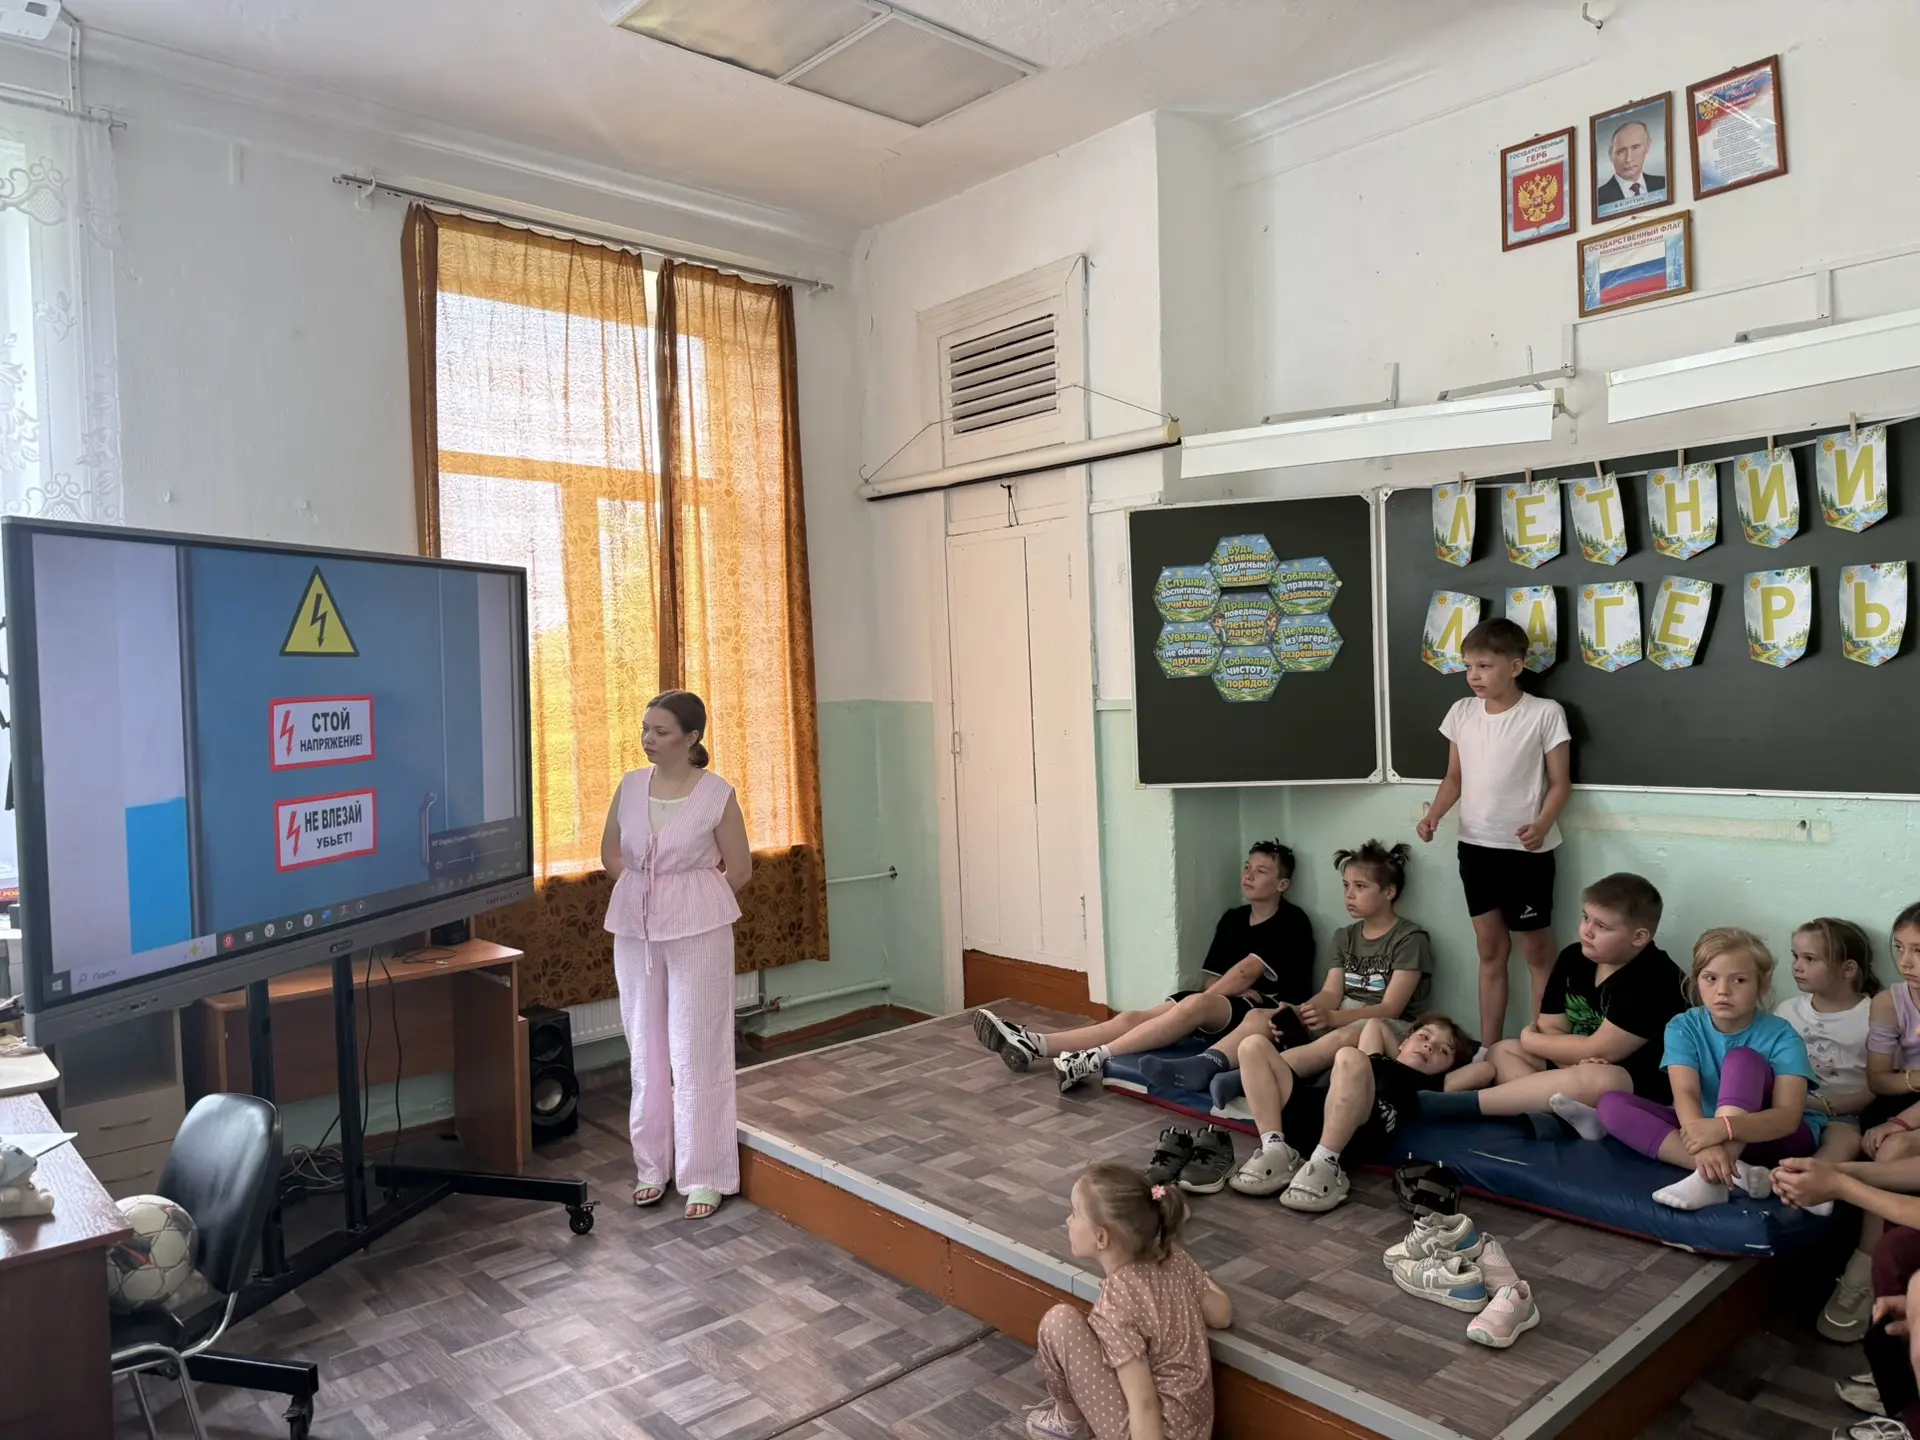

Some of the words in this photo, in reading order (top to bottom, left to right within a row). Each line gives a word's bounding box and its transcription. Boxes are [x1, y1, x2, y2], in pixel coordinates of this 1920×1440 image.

[1526, 151, 1547, 163] ГЕРБ
[1585, 227, 1659, 253] ГОСУДАРСТВЕННЫЙ
[1661, 221, 1682, 232] ФЛАГ
[1228, 546, 1253, 555] Будь
[1222, 561, 1266, 573] дружным
[1165, 577, 1206, 588] Слушай
[1287, 581, 1323, 590] правила
[1161, 587, 1211, 598] воспитателей
[1280, 590, 1332, 600] безопасности
[1166, 600, 1209, 610] учителей
[1223, 602, 1269, 611] Правила
[1224, 608, 1267, 617] поведения
[1436, 582, 1891, 654] ЛАГЕРЬ
[1227, 620, 1264, 629] летнем
[1228, 628, 1264, 637] лагере
[1283, 627, 1296, 636] Не
[1297, 626, 1327, 635] уходи
[1167, 632, 1208, 644] Уважай
[1285, 638, 1296, 646] из
[1298, 635, 1329, 644] лагеря
[1165, 650, 1176, 658] не
[1177, 647, 1211, 655] обижай
[1281, 649, 1333, 659] разрешения
[1172, 657, 1206, 667] других
[1223, 656, 1271, 667] Соблюдай
[1226, 666, 1268, 677] чистоту
[1226, 679, 1269, 690] порядок
[312, 706, 350, 733] СТОЙ
[300, 734, 363, 752] НАПРЯЖЕНИЕ!
[304, 811, 319, 833] НЕ
[322, 800, 362, 830] ВЛЕЗАЙ
[316, 832, 353, 849] УБЬЕТ!
